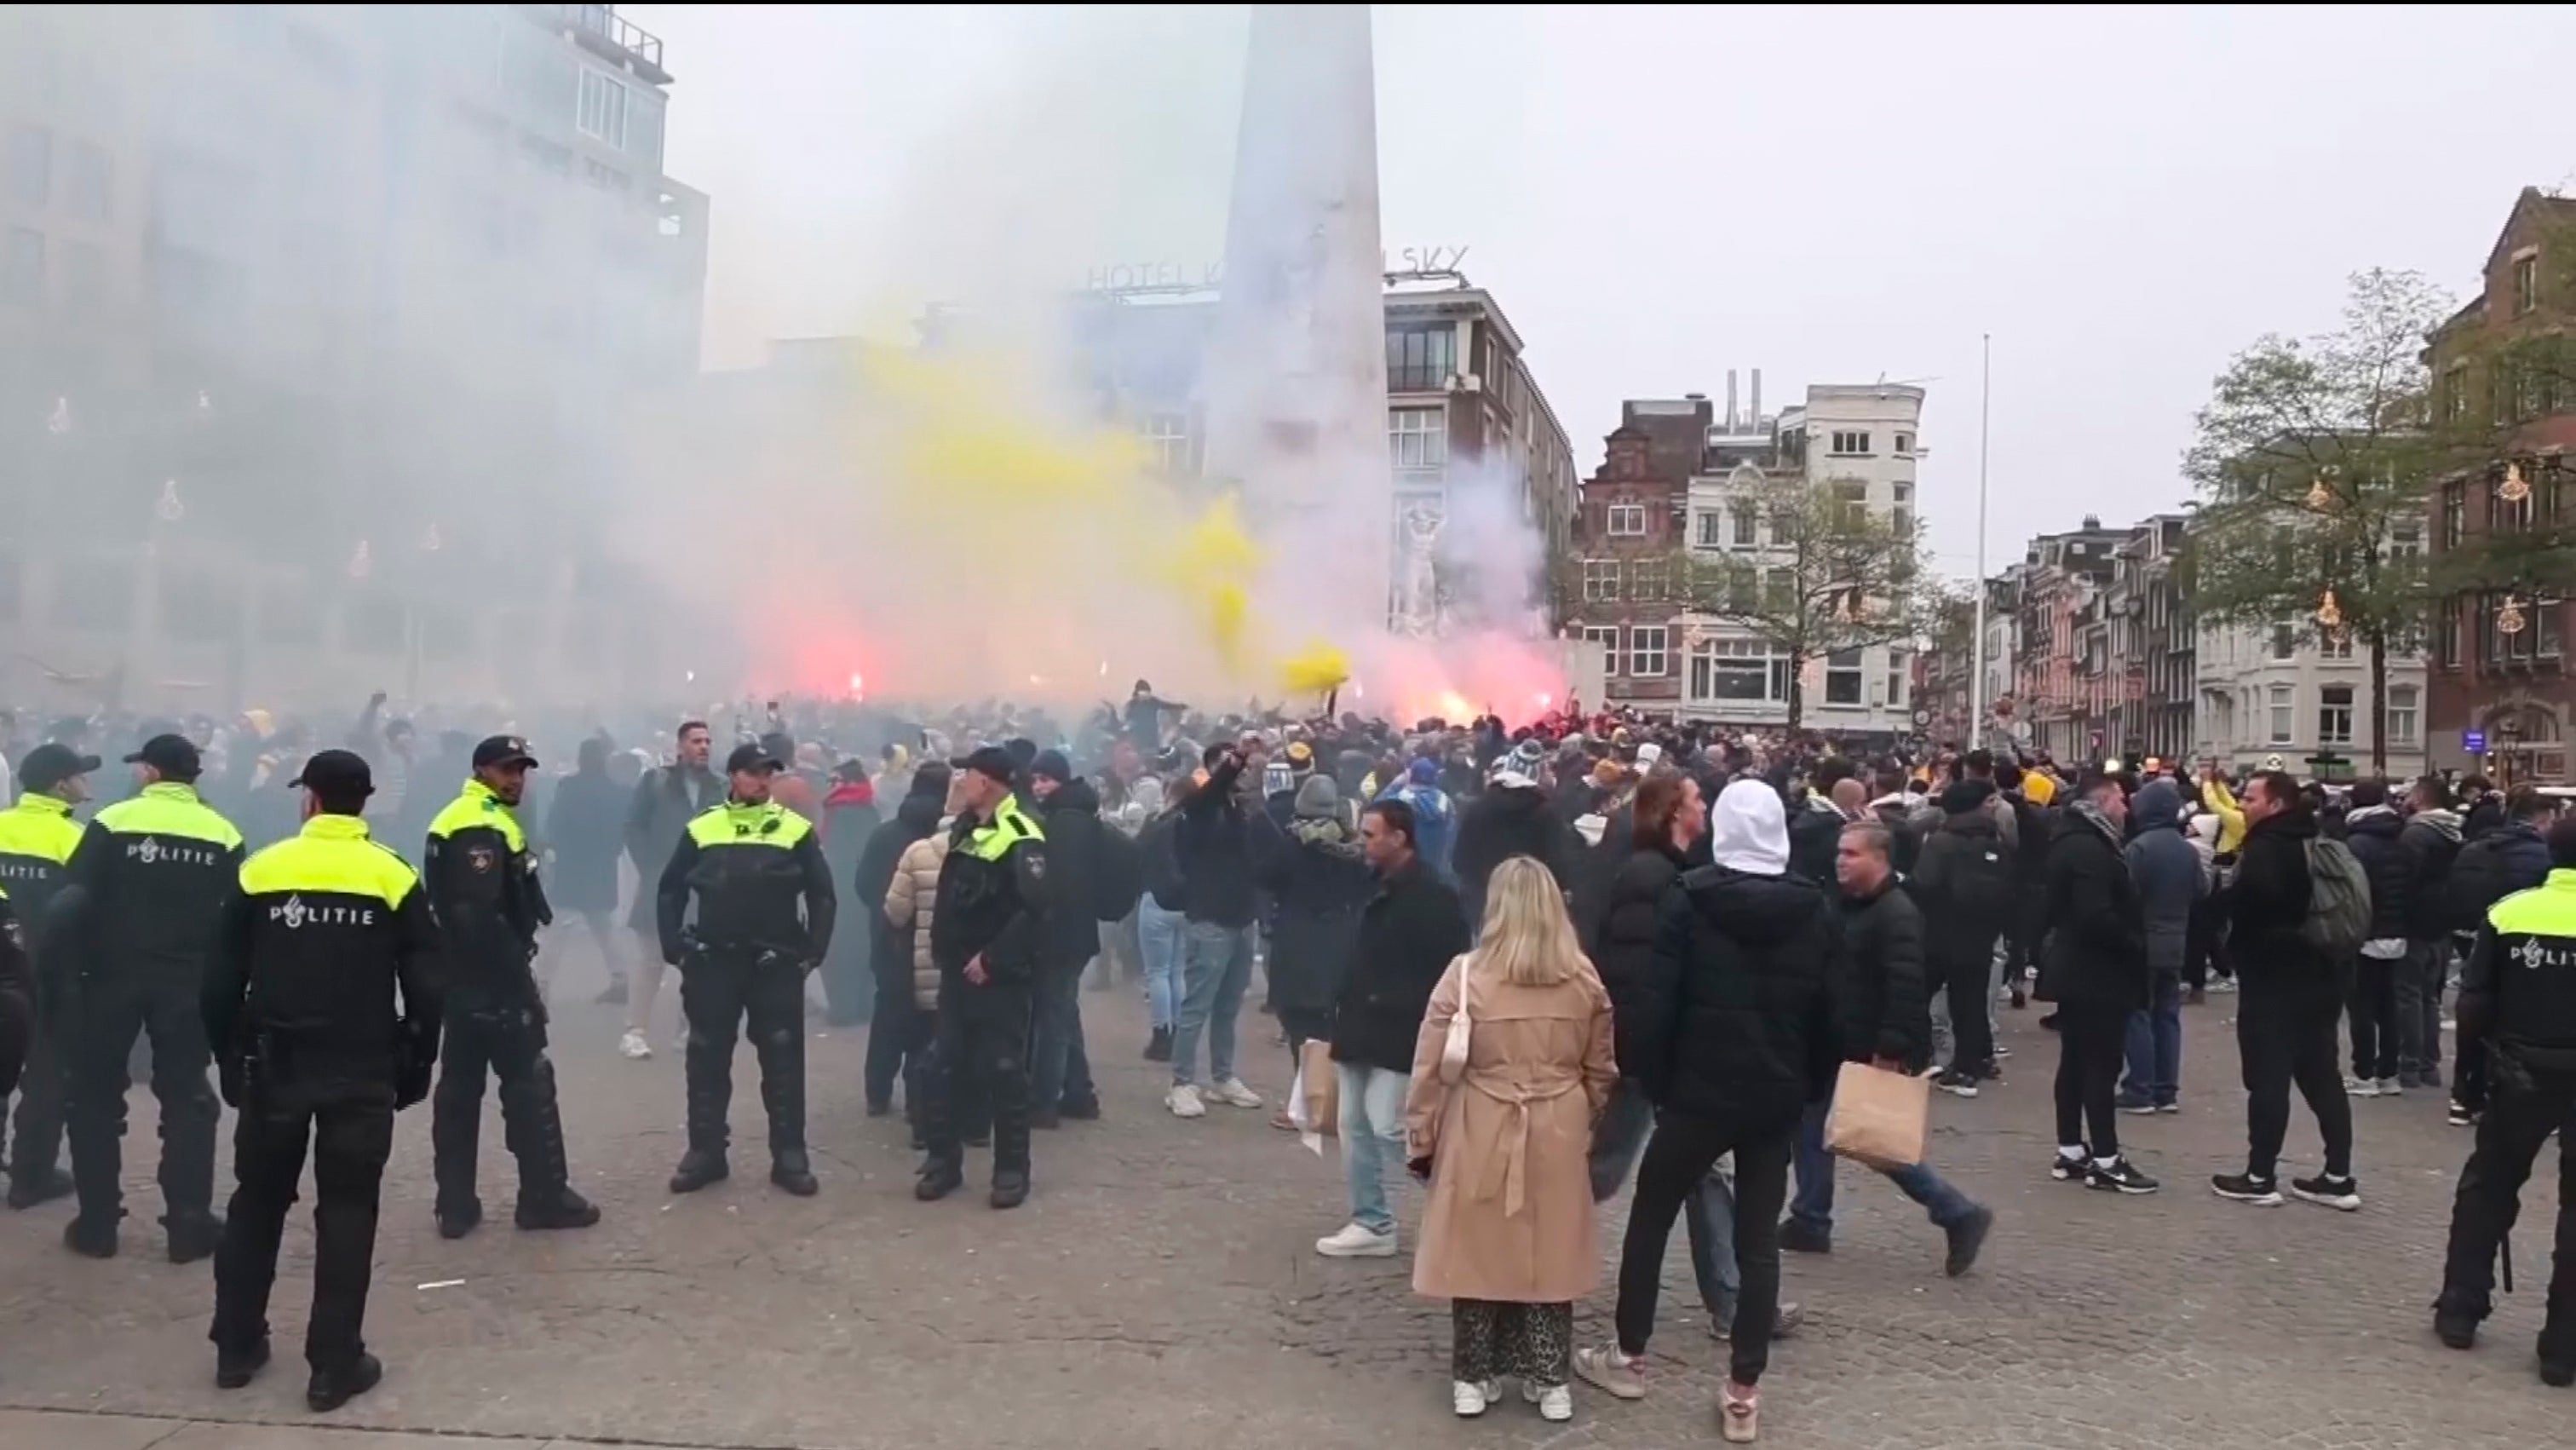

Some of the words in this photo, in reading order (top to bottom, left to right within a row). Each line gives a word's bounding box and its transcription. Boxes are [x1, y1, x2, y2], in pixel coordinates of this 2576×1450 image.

[1088, 261, 1190, 290] HOTEL
[126, 835, 216, 866] POLITIE
[269, 893, 375, 928] POLITIE
